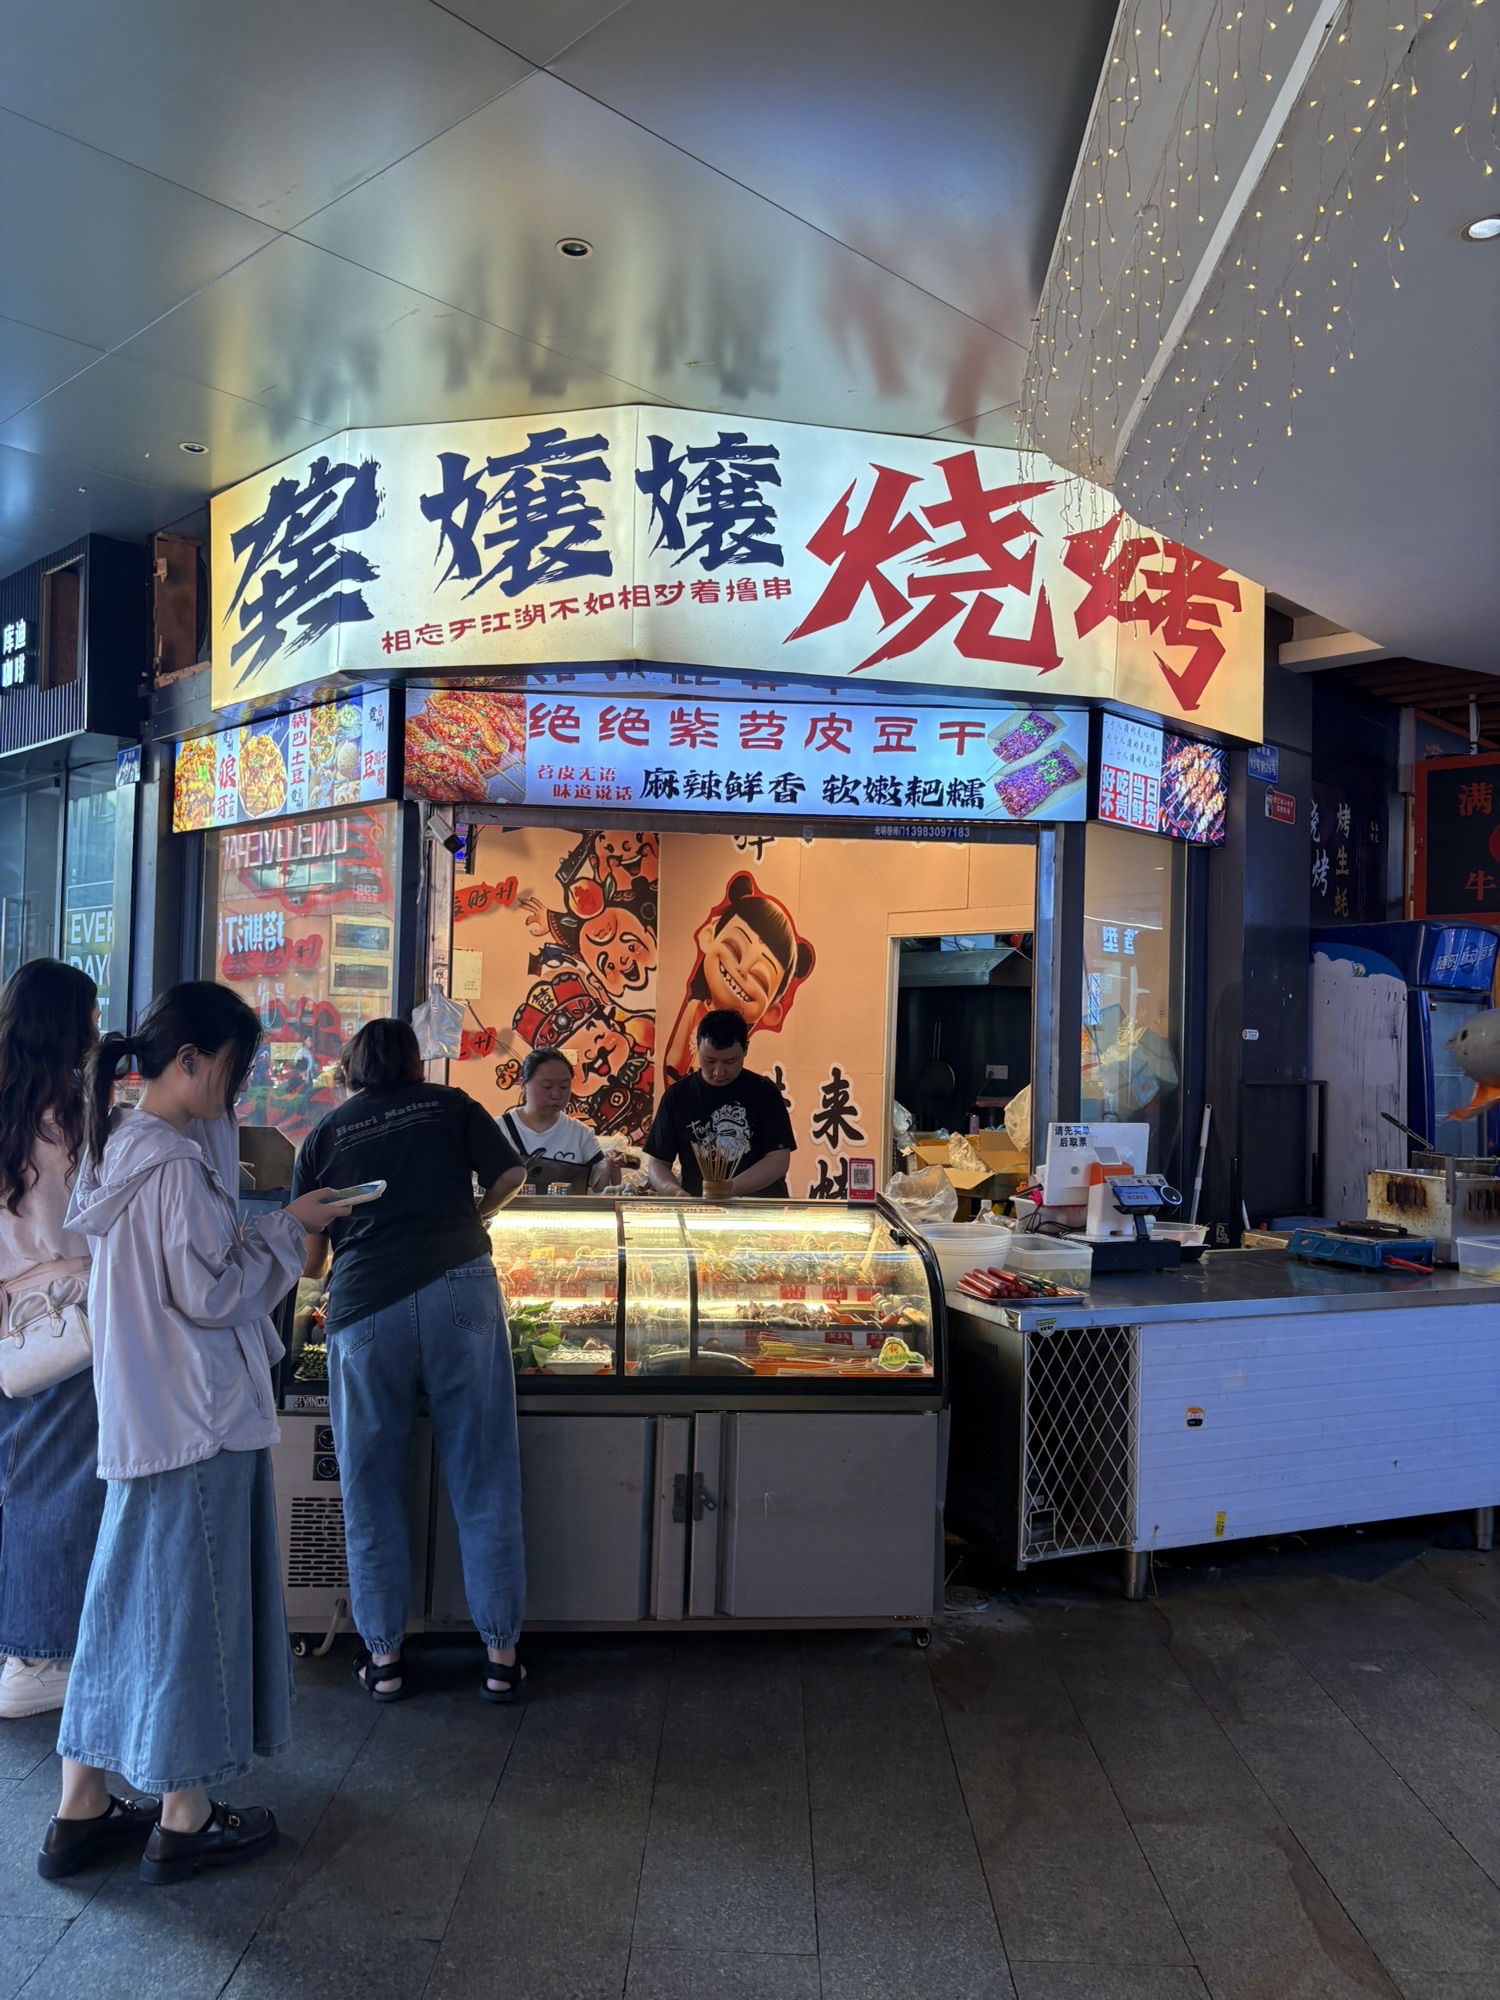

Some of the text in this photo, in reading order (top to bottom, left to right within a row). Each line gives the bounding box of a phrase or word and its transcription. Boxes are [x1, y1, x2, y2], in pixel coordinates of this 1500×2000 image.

[382, 577, 792, 654] 相忘于江湖不如相对着撸串
[3, 619, 26, 655] 库迪
[528, 702, 986, 756] 绝绝紫苕皮豆干
[536, 765, 617, 782] 苕皮无语
[640, 767, 807, 805] 麻辣鲜香
[1102, 767, 1129, 796] 好吃
[553, 784, 633, 801] 味道说话
[1133, 775, 1158, 803] 当日
[1458, 782, 1493, 816] 满
[1101, 792, 1128, 820] 不贵
[1132, 799, 1157, 827] 鲜货
[1465, 870, 1497, 901] 牛
[336, 1116, 378, 1137] Henri
[385, 1100, 439, 1120] Matisse
[813, 1067, 865, 1149] 来
[1055, 1125, 1091, 1136] 请先买单
[1059, 1137, 1088, 1148] 后取票
